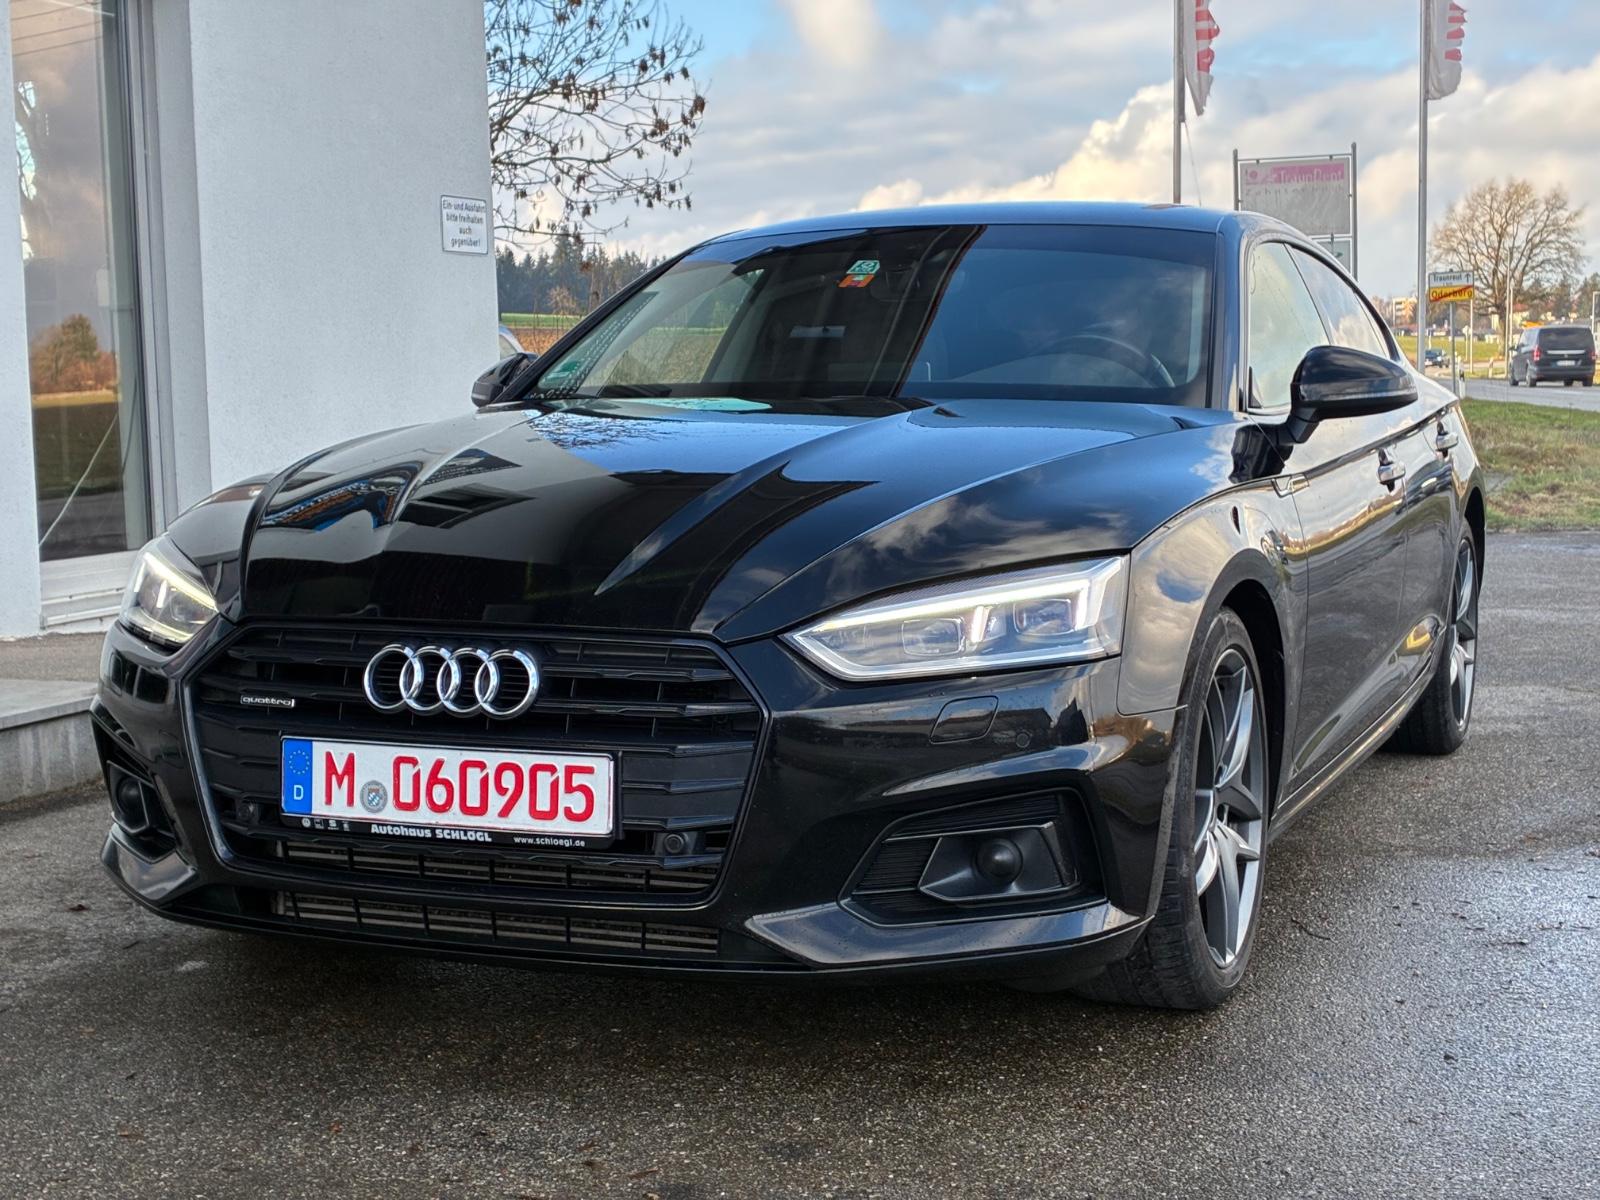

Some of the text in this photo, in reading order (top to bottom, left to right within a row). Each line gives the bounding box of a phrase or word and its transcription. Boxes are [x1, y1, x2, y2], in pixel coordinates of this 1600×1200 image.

[453, 201, 464, 211] und
[446, 212, 458, 222] bitte
[459, 227, 472, 235] auch
[241, 696, 292, 706] quattro
[324, 750, 596, 823] M 060905
[293, 784, 304, 801] D
[370, 823, 586, 847] Autohaus SCHLÖGL www.schloegl.de
